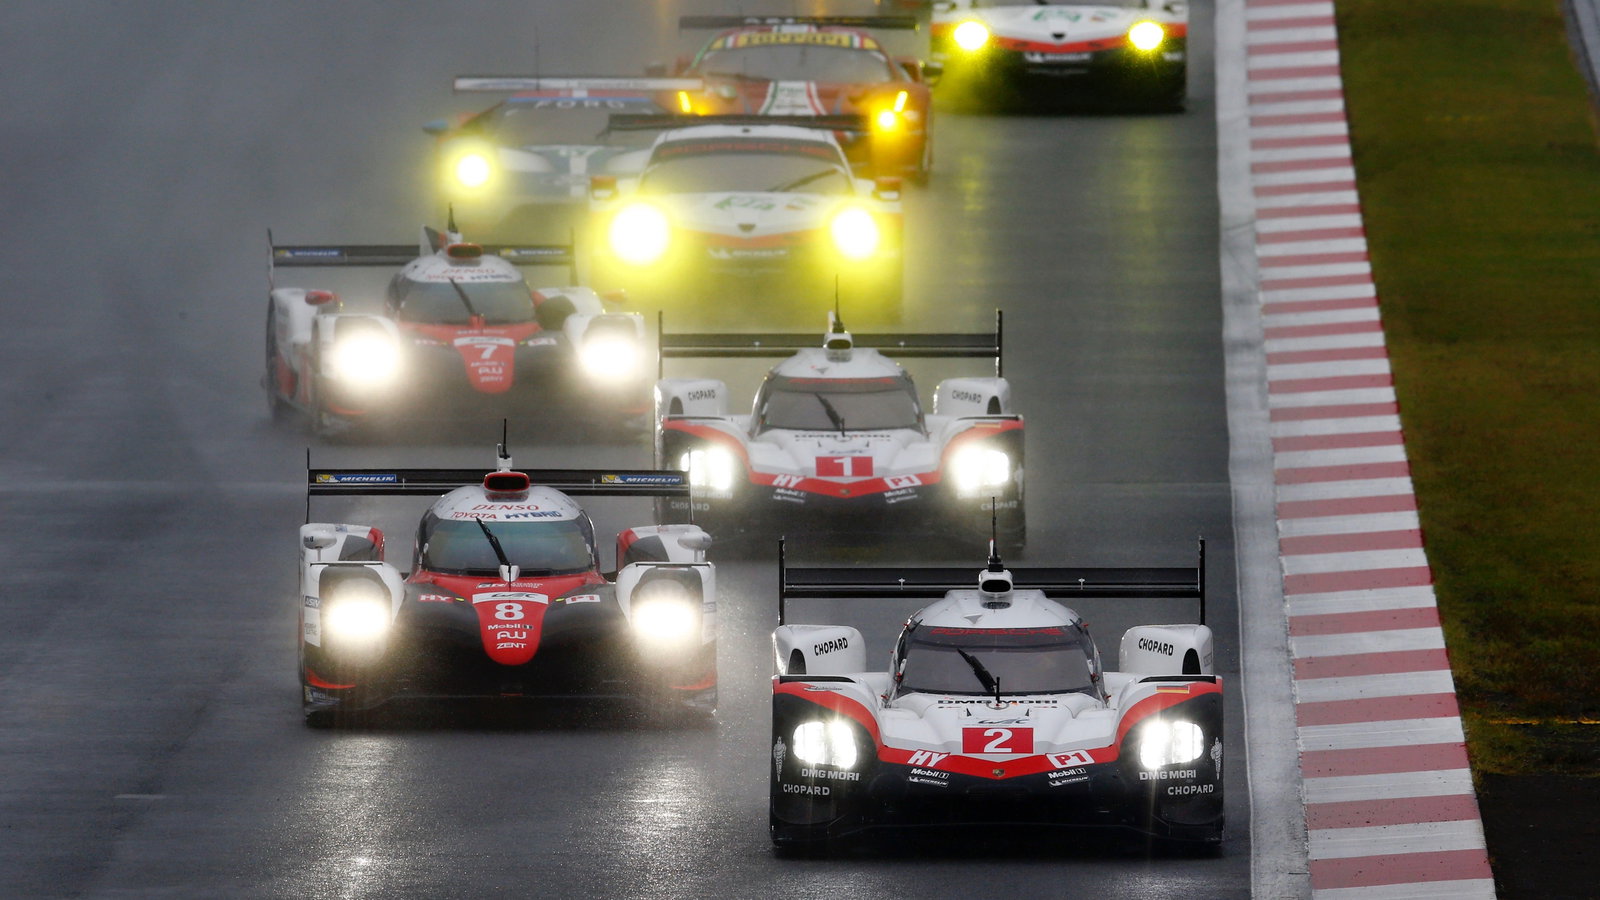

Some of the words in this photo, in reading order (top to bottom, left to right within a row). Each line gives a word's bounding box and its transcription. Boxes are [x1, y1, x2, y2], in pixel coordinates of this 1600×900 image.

[474, 344, 498, 360] 7
[687, 389, 716, 401] CHOPARD
[951, 390, 983, 404] CHOPARD
[833, 457, 854, 477] 1
[339, 474, 395, 483] MICHELIN
[624, 474, 682, 483] MICHELIN
[772, 474, 804, 488] HY
[451, 511, 497, 519] TOYOTA
[505, 510, 562, 519] HYBRID
[495, 602, 525, 621] 8
[813, 637, 849, 656] CHOPARD
[1138, 637, 1174, 656] CHOPARD
[983, 728, 1013, 753] 2
[907, 750, 949, 767] HY
[1054, 752, 1088, 766] P1
[801, 768, 826, 778] DMG
[827, 770, 860, 781] MORI
[910, 768, 939, 777] Mobil
[1047, 769, 1076, 779] Mobil
[1139, 771, 1168, 780] DMG
[1169, 769, 1197, 779] MORI
[783, 783, 831, 796] CHOPARD
[1167, 783, 1214, 796] CHOPARD
